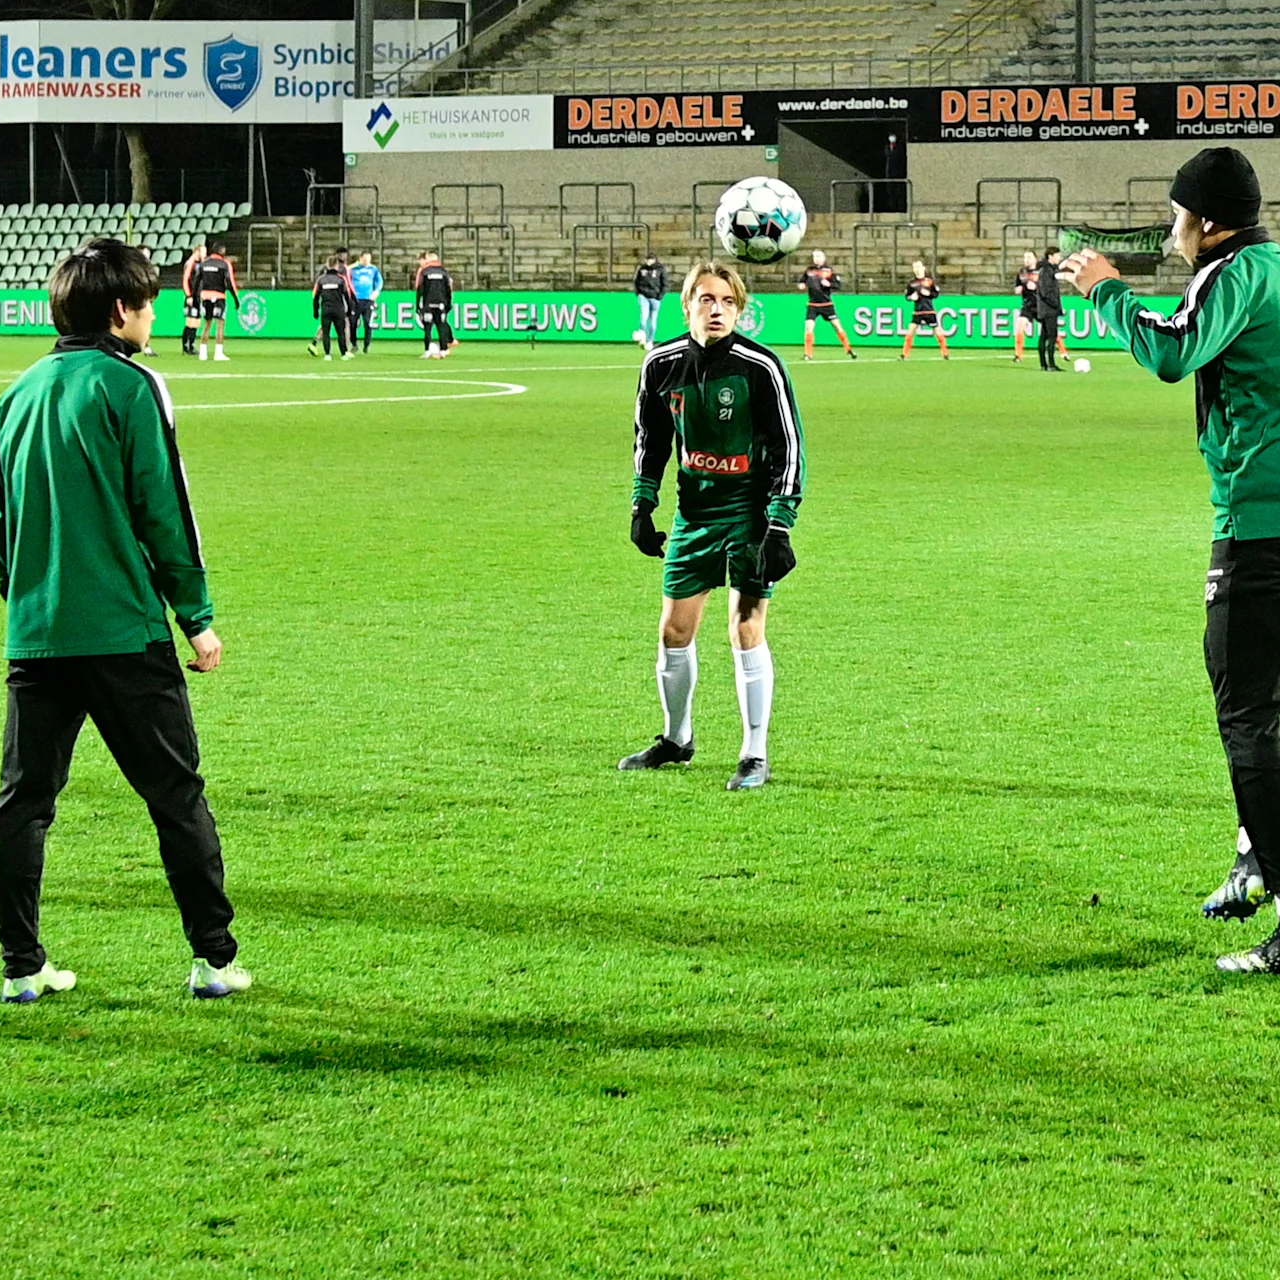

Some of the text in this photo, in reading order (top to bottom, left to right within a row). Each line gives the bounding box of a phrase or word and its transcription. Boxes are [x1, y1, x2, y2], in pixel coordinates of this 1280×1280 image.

[2, 82, 141, 99] RAMENWASSER
[147, 89, 205, 99] Partner van
[568, 95, 743, 130] DERDAELE
[778, 97, 909, 111] www.derdaele.be
[941, 87, 1137, 122] DERDAELE
[941, 122, 1130, 140] industriële gebouwen
[1176, 118, 1274, 135] industriële
[568, 128, 738, 146] industriële gebouwen
[719, 408, 733, 420] 21
